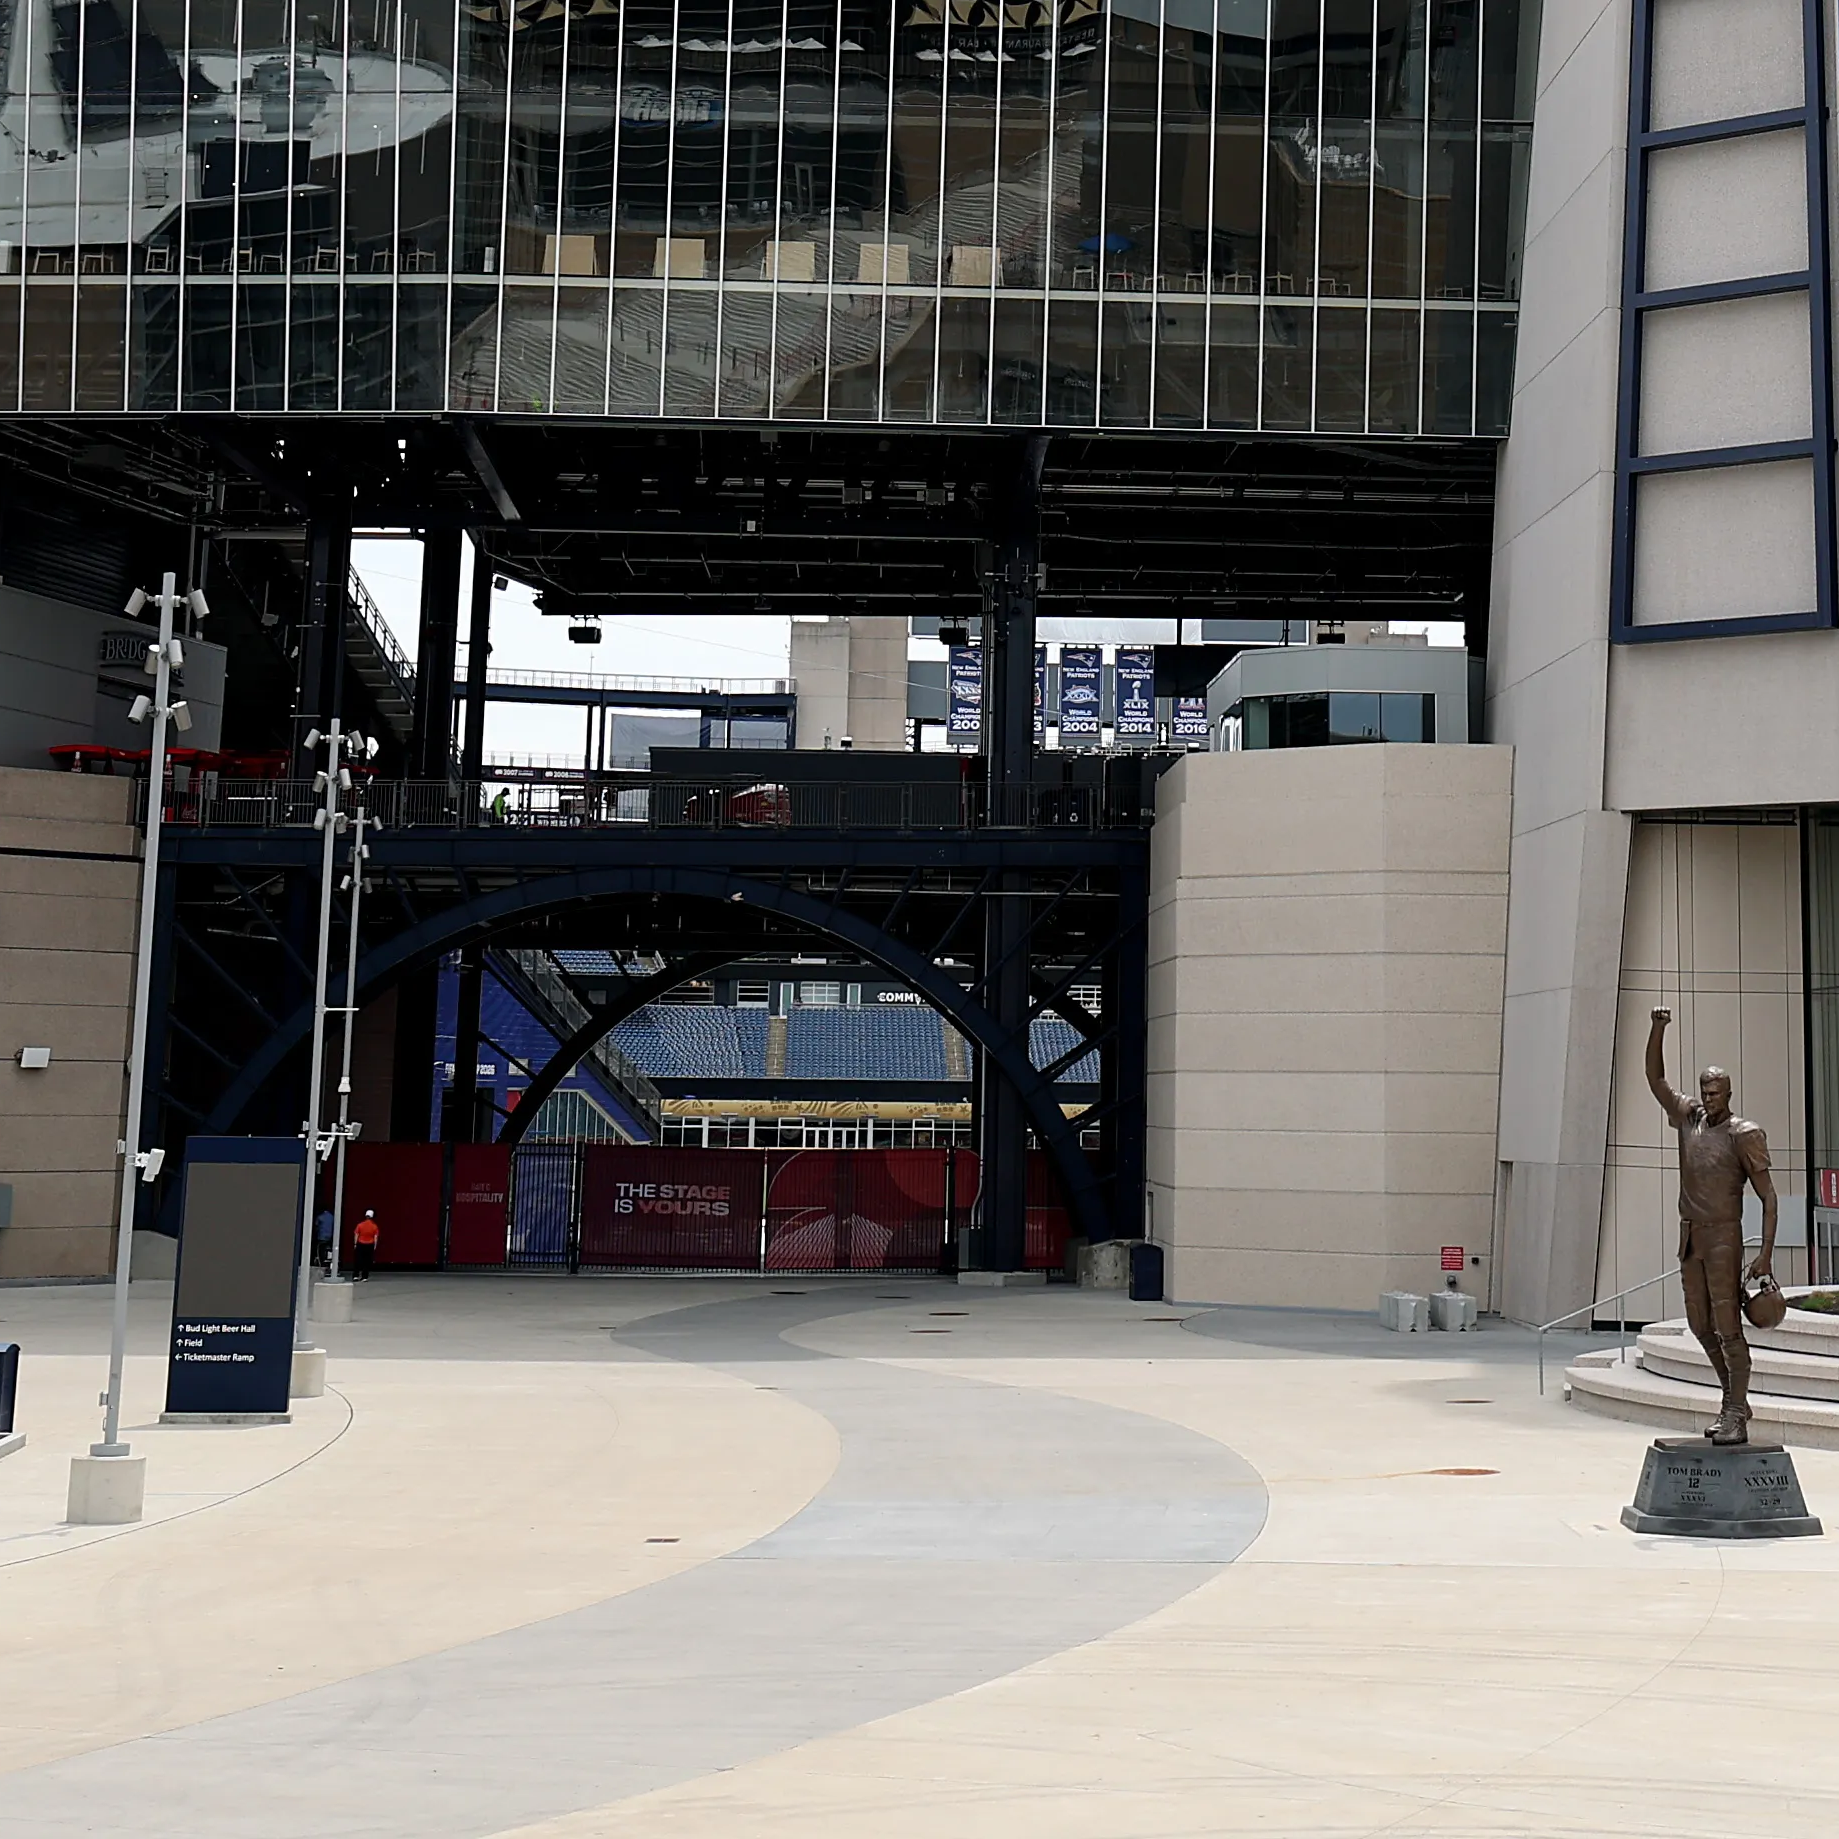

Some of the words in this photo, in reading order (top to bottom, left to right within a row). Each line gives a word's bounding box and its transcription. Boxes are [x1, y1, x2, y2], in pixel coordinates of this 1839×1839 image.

[105, 638, 147, 661] BRIDG
[1123, 701, 1149, 709] XLIX
[952, 720, 980, 730] 200
[1062, 722, 1098, 732] 2004
[1120, 723, 1152, 733] 2014
[1175, 724, 1207, 734] 2016
[616, 1182, 656, 1198] THE
[659, 1184, 731, 1200] STAGE
[614, 1198, 634, 1214] IS
[637, 1199, 730, 1217] YOURS
[185, 1324, 201, 1333] Bud
[202, 1324, 221, 1334] Light
[221, 1324, 240, 1333] Beer
[240, 1324, 256, 1333] Hall
[184, 1338, 203, 1347] Field
[183, 1353, 231, 1362] Ticketmaster
[232, 1353, 255, 1363] Ramp
[1667, 1466, 1688, 1476] TOM
[1689, 1468, 1722, 1478] BRADY
[1688, 1478, 1700, 1489] 12
[1743, 1475, 1789, 1487] XXXVIII
